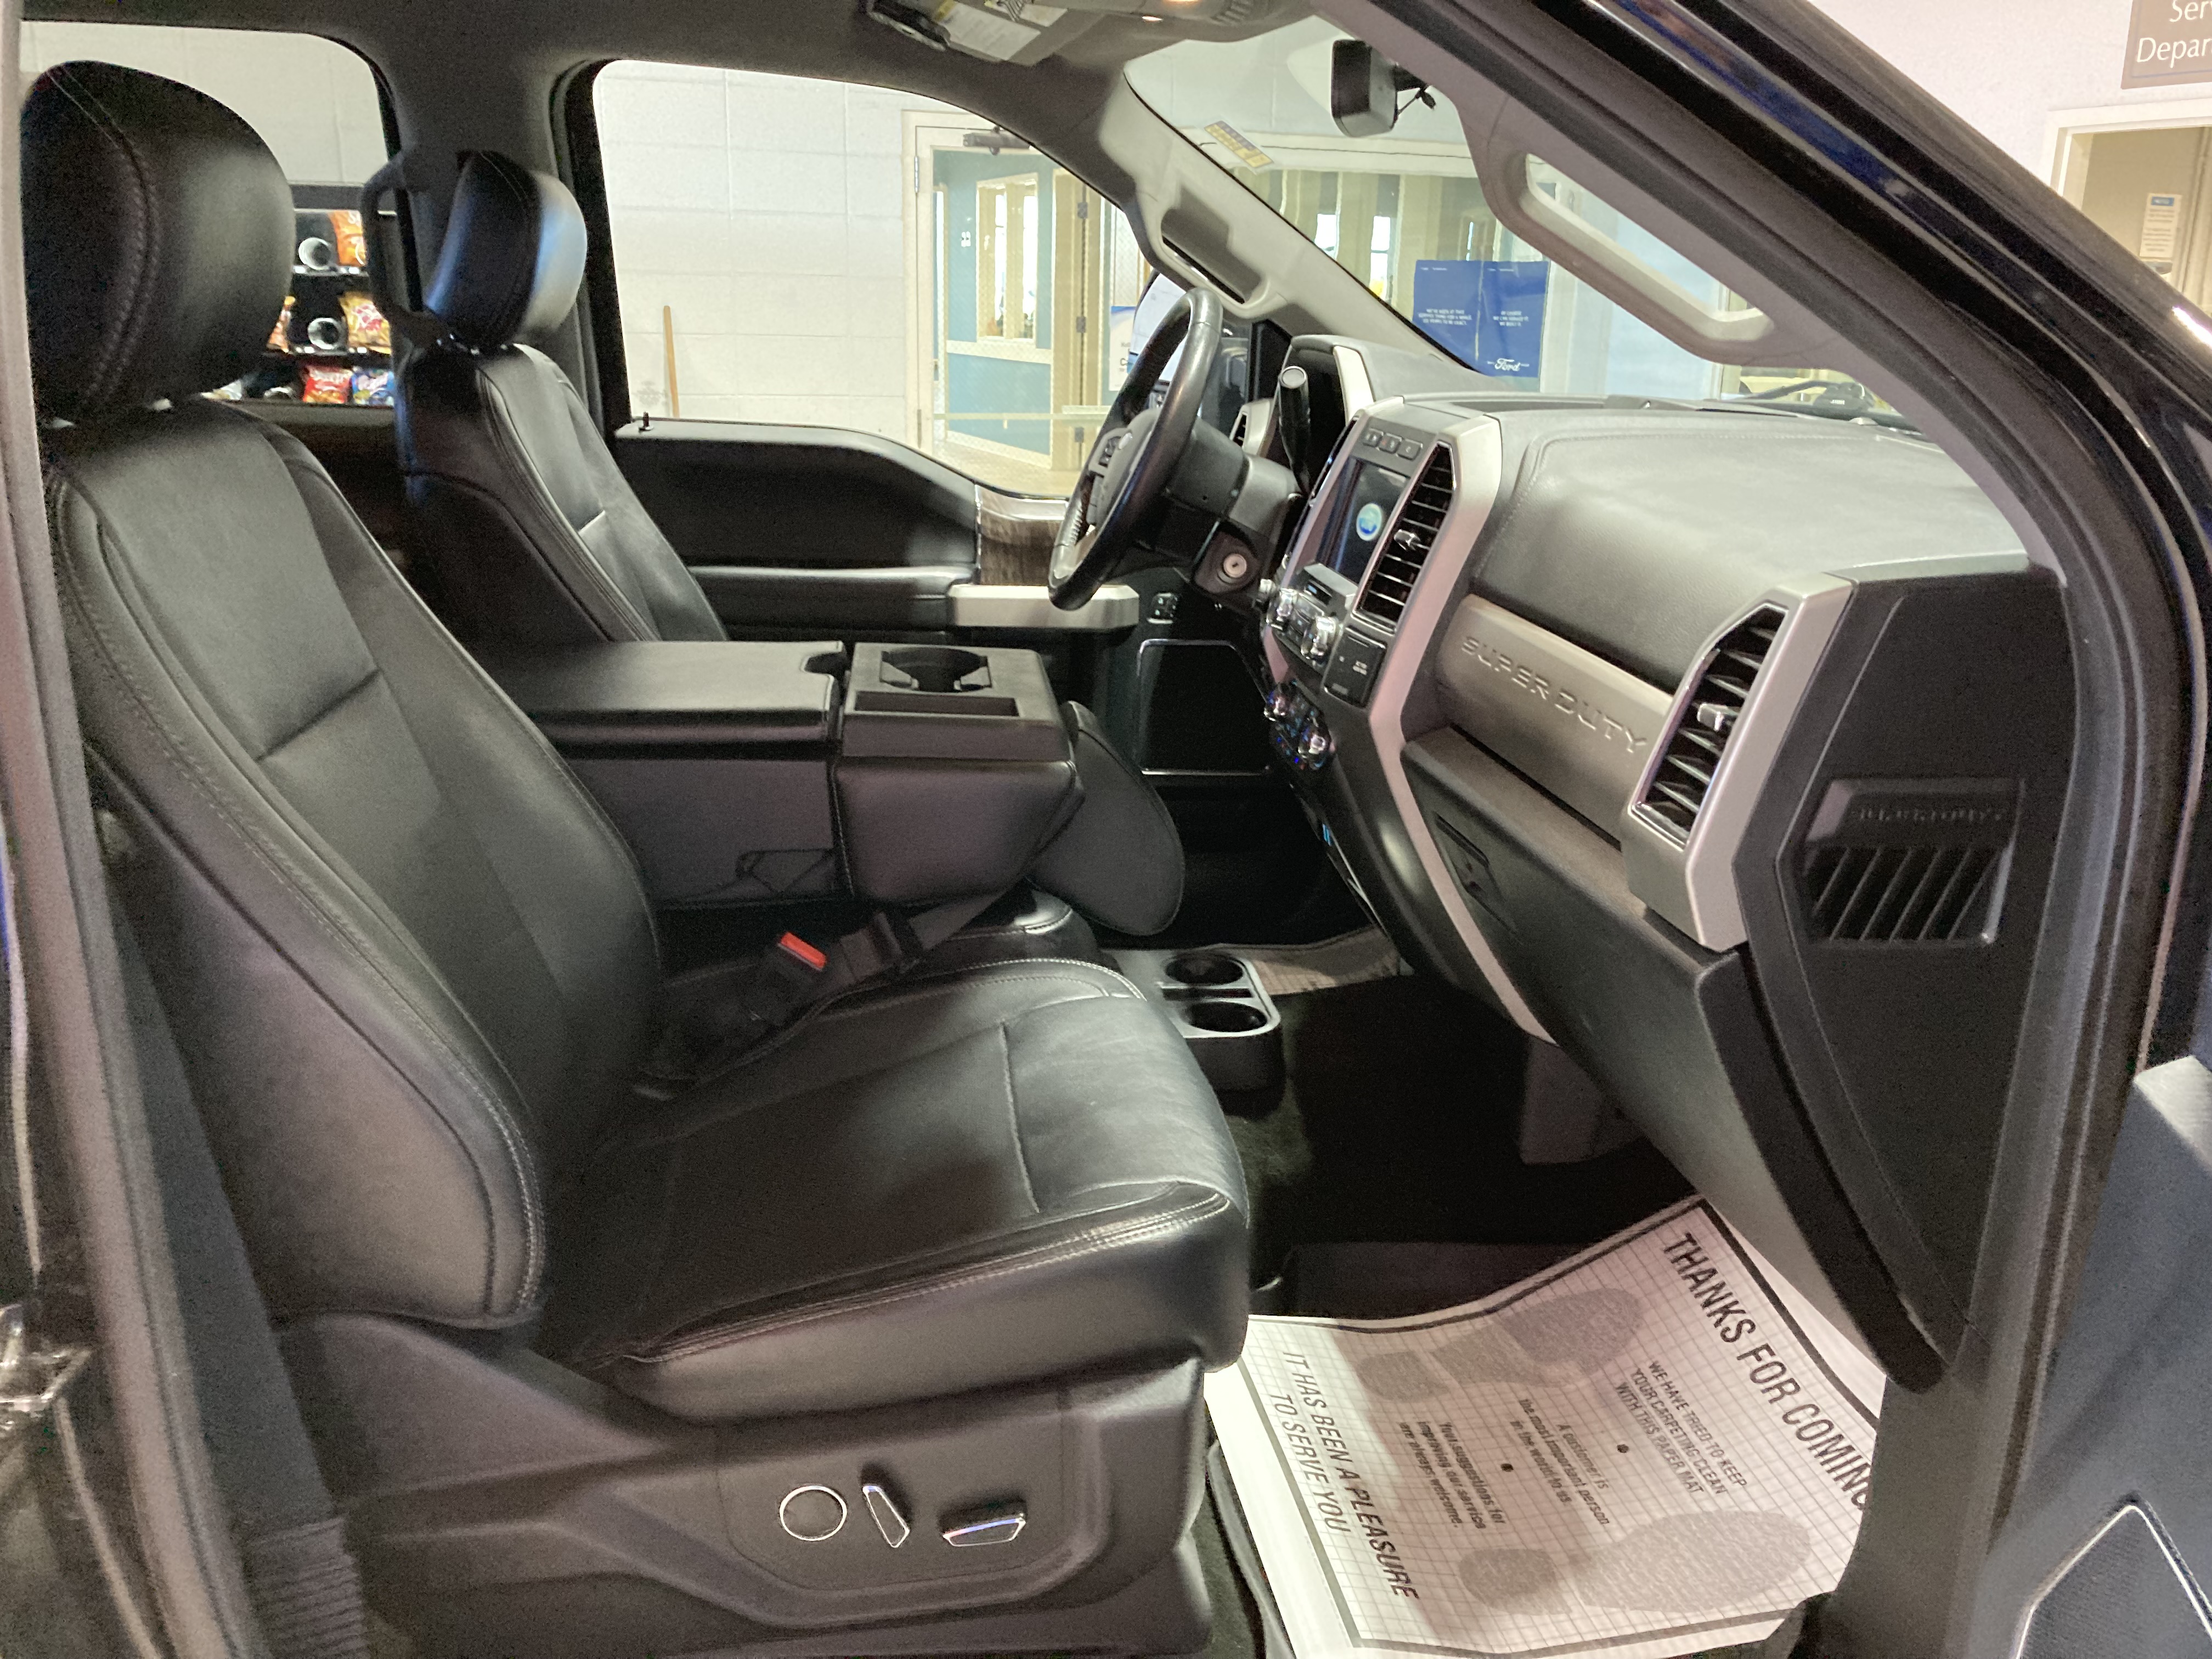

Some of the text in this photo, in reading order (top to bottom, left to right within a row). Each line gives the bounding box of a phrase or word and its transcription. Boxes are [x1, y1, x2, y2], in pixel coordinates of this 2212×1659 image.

[2137, 37, 2212, 69] Depar
[2169, 0, 2212, 22] Ser
[1494, 358, 1521, 371] Ford
[1460, 635, 1647, 754] SUPER DUTY
[1663, 1231, 1757, 1344] THANKS
[1736, 1342, 1801, 1404] FOR
[1270, 1393, 1351, 1533] TO SERVE YOU
[1562, 1433, 1602, 1477] customer
[1594, 1479, 1609, 1489] is
[1616, 1381, 1705, 1493] WITH THIS PAPER MAT
[1630, 1368, 1728, 1494] YOUR CARPETING CLEAN
[1649, 1360, 1747, 1486] WE HAVE TRIED TO KEEP
[1283, 1352, 1421, 1600] IT HAS BEEN A PLEASURE
[1456, 1488, 1487, 1529] service
[1487, 1508, 1506, 1523] for
[1575, 1489, 1610, 1525] person
